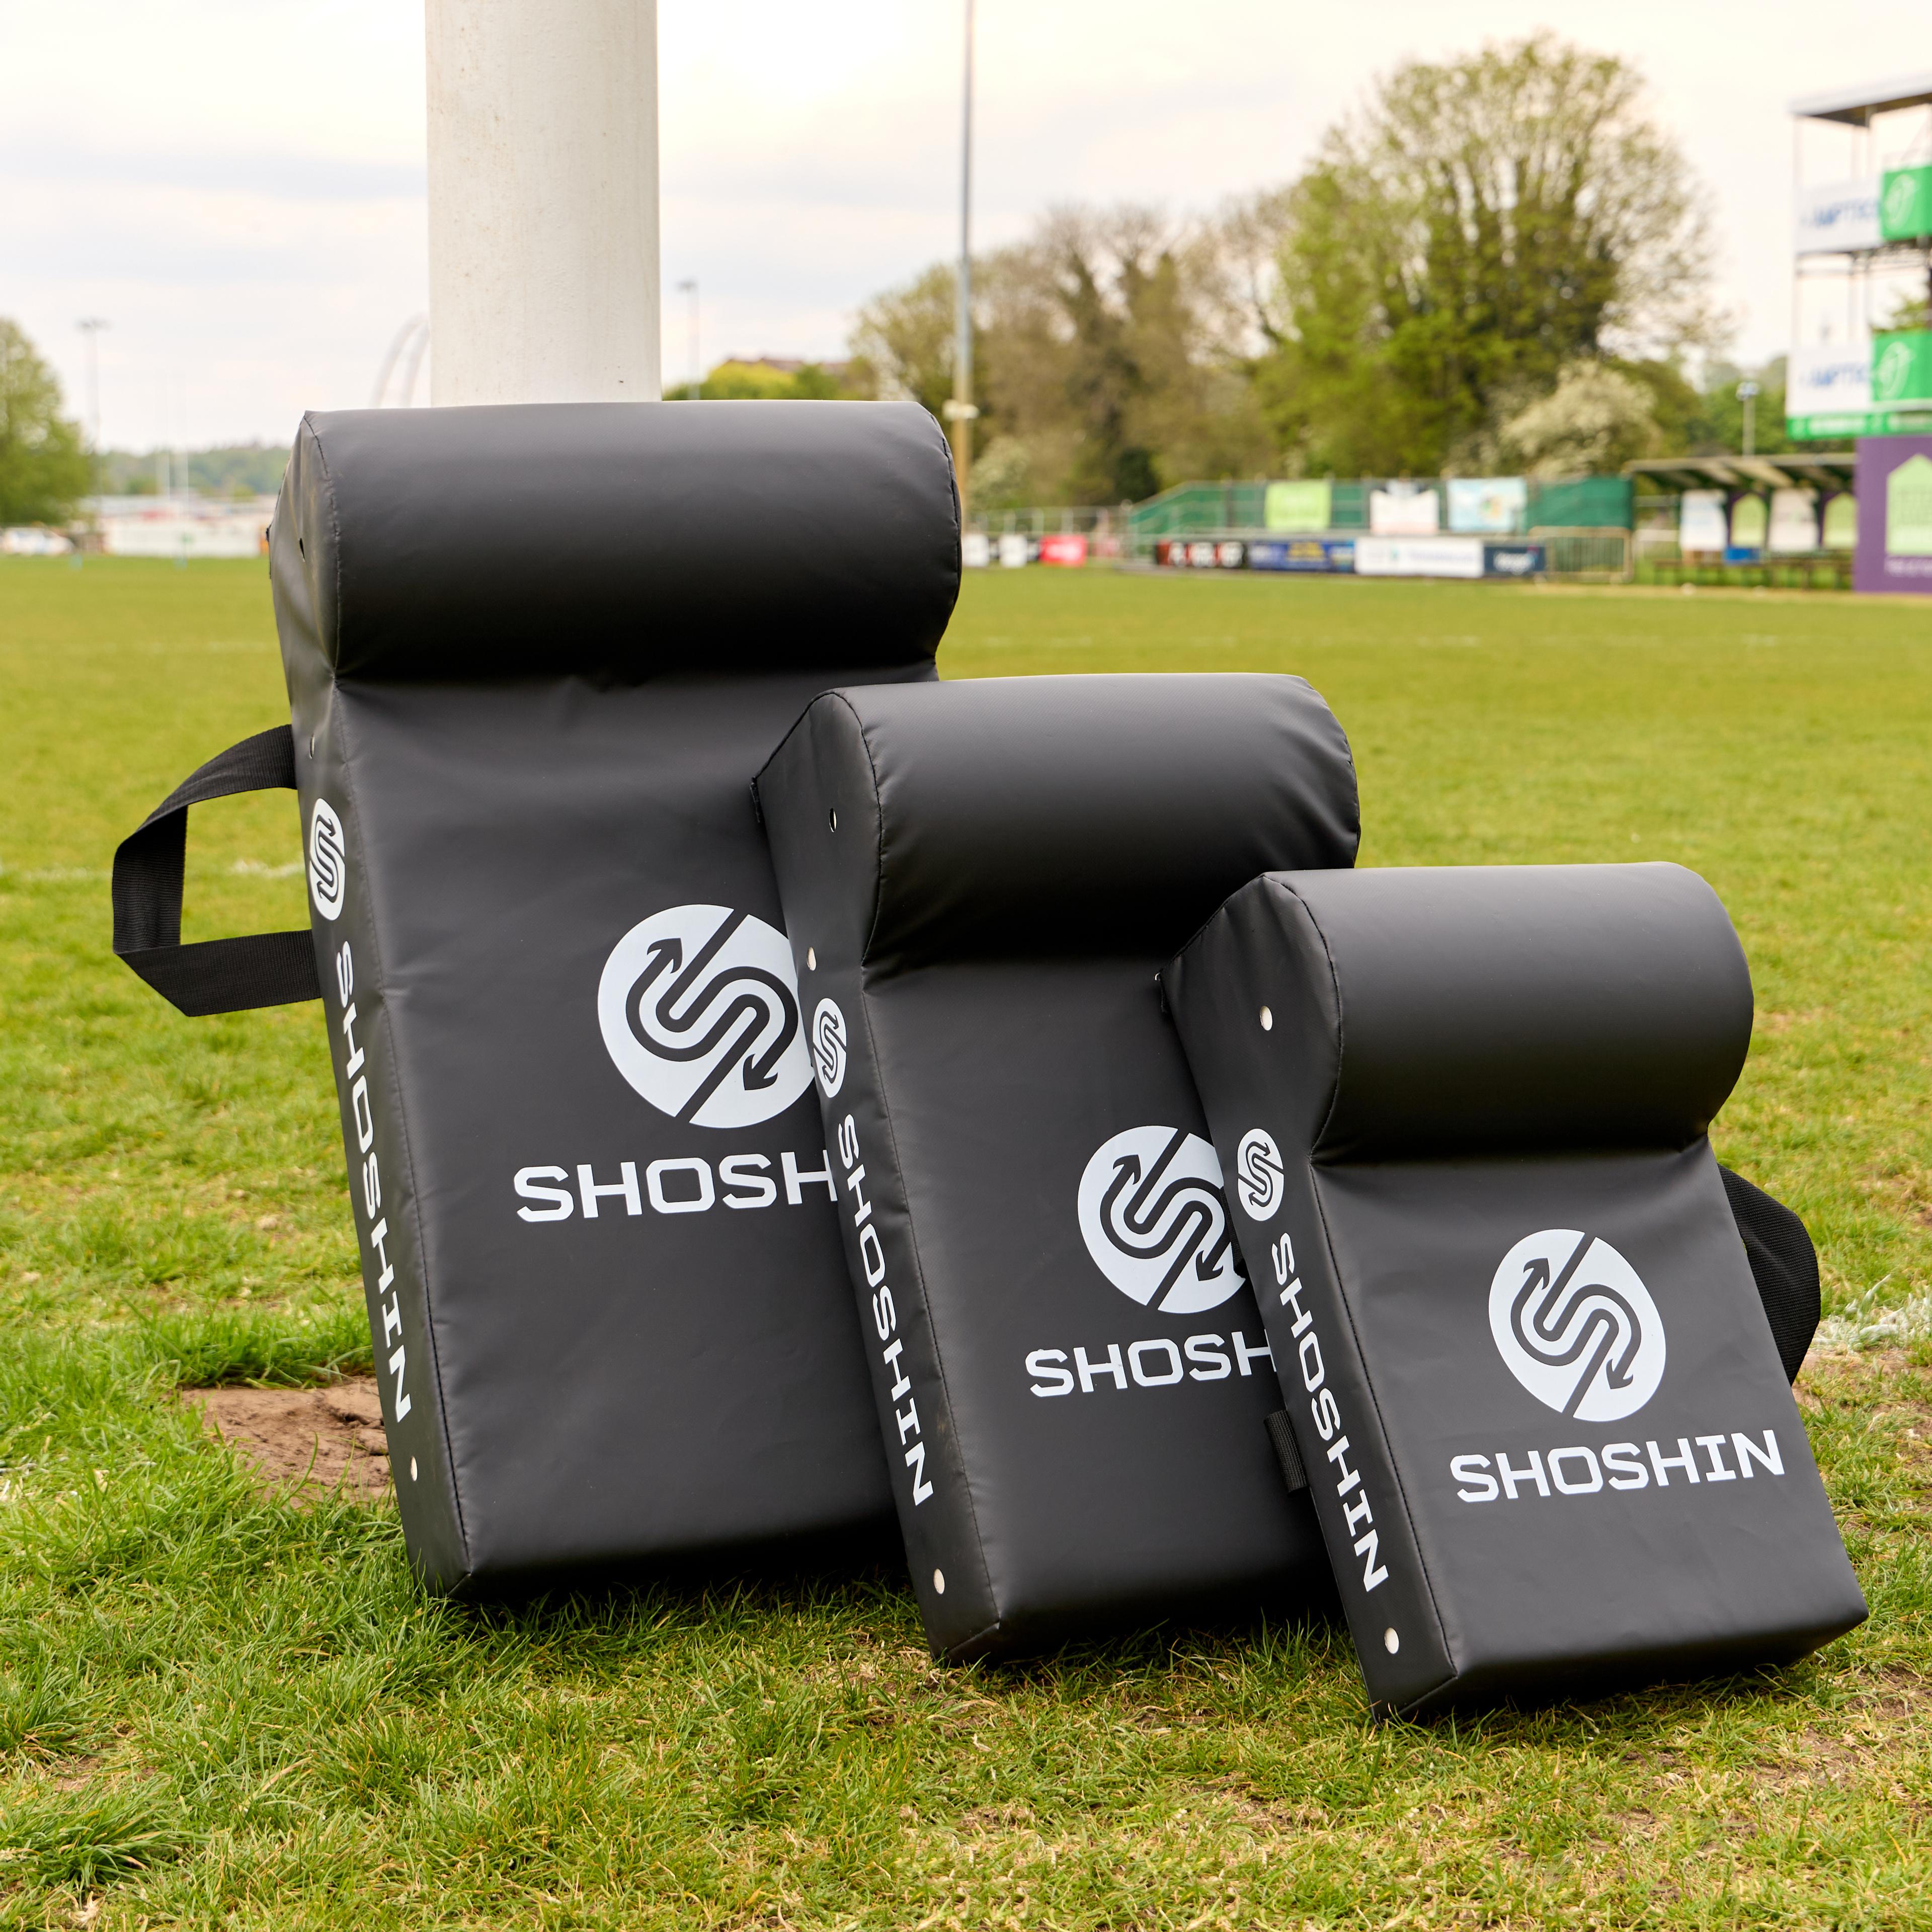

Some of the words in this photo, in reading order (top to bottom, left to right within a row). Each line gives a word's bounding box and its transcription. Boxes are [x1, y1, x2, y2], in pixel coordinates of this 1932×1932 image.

[336, 940, 412, 1423] SHOSHIN
[837, 1113, 934, 1506] SHOSHIN
[1271, 1232, 1389, 1592] SHOSHIN
[1450, 1429, 1786, 1503] SHOSHIN
